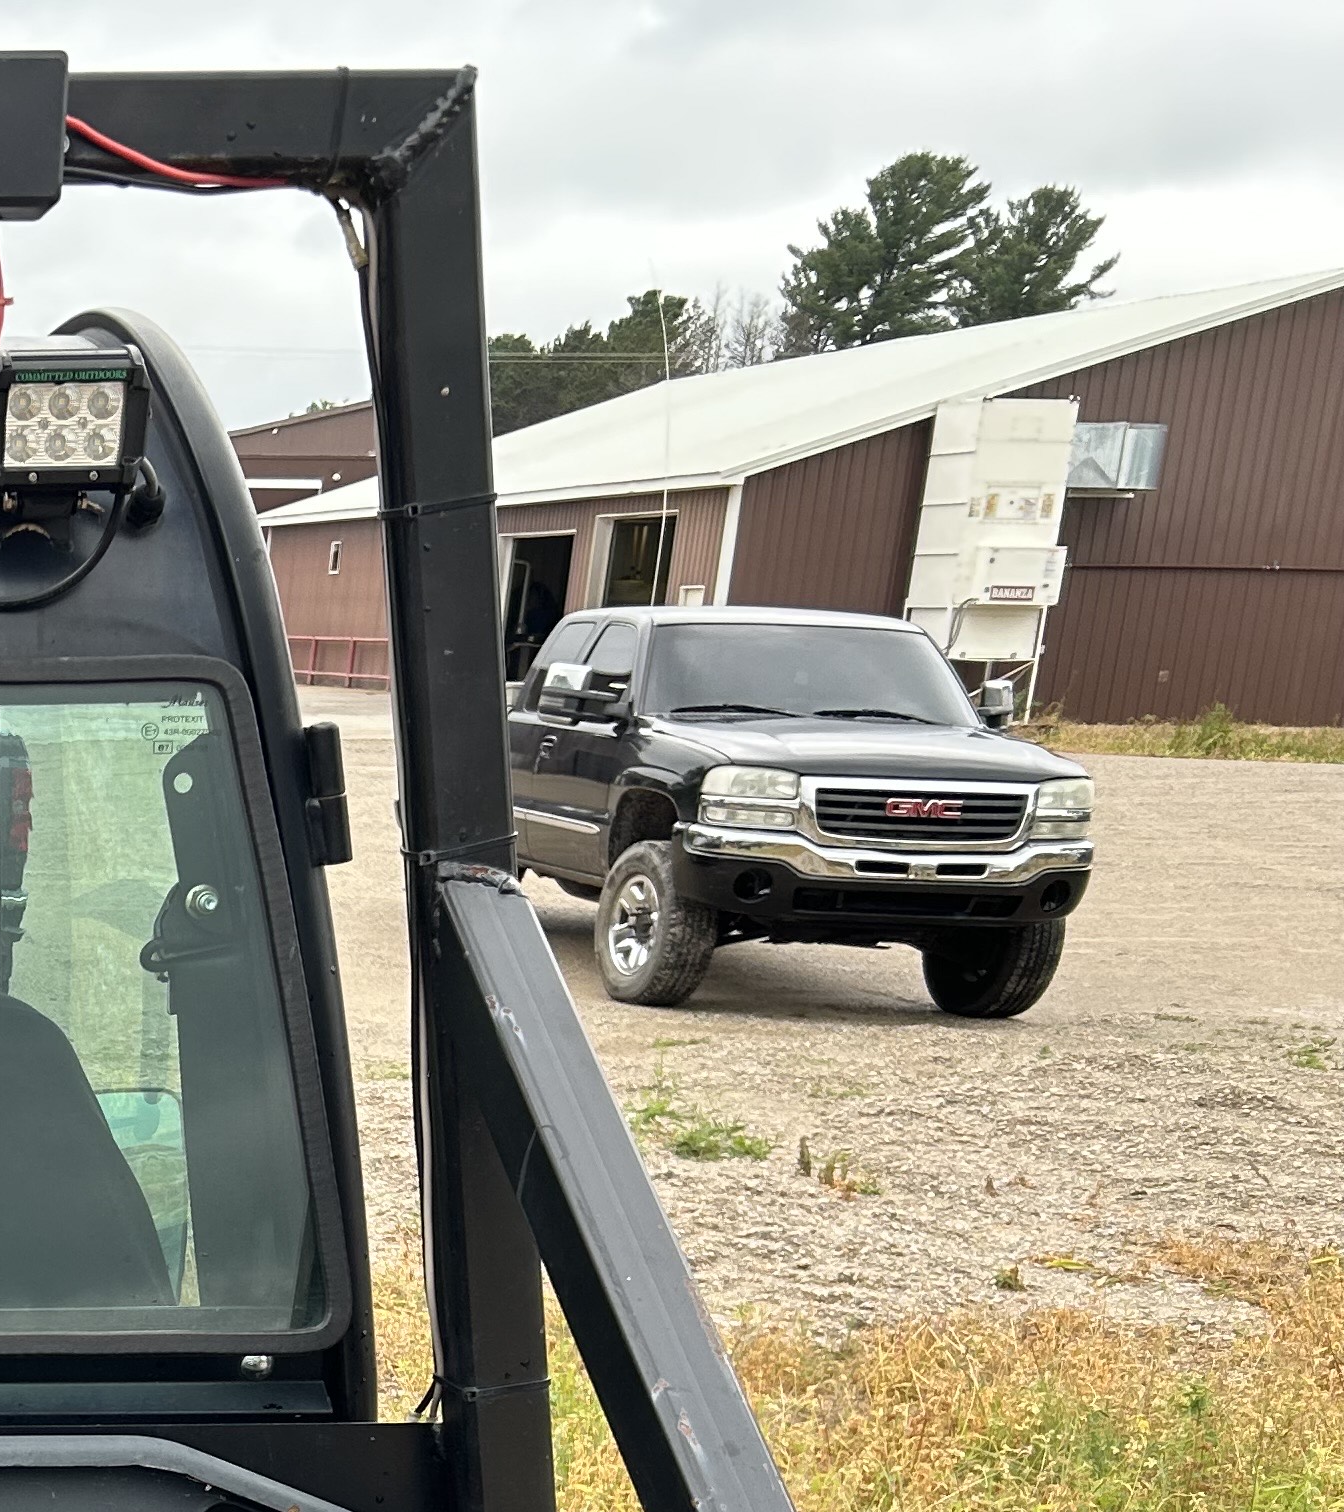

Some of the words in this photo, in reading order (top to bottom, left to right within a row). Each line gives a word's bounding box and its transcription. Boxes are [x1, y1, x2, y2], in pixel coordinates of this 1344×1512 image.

[15, 371, 73, 382] COMMITTED
[74, 369, 127, 380] OUTDOORS
[991, 587, 1033, 599] BANANZA
[886, 798, 964, 819] GMC
